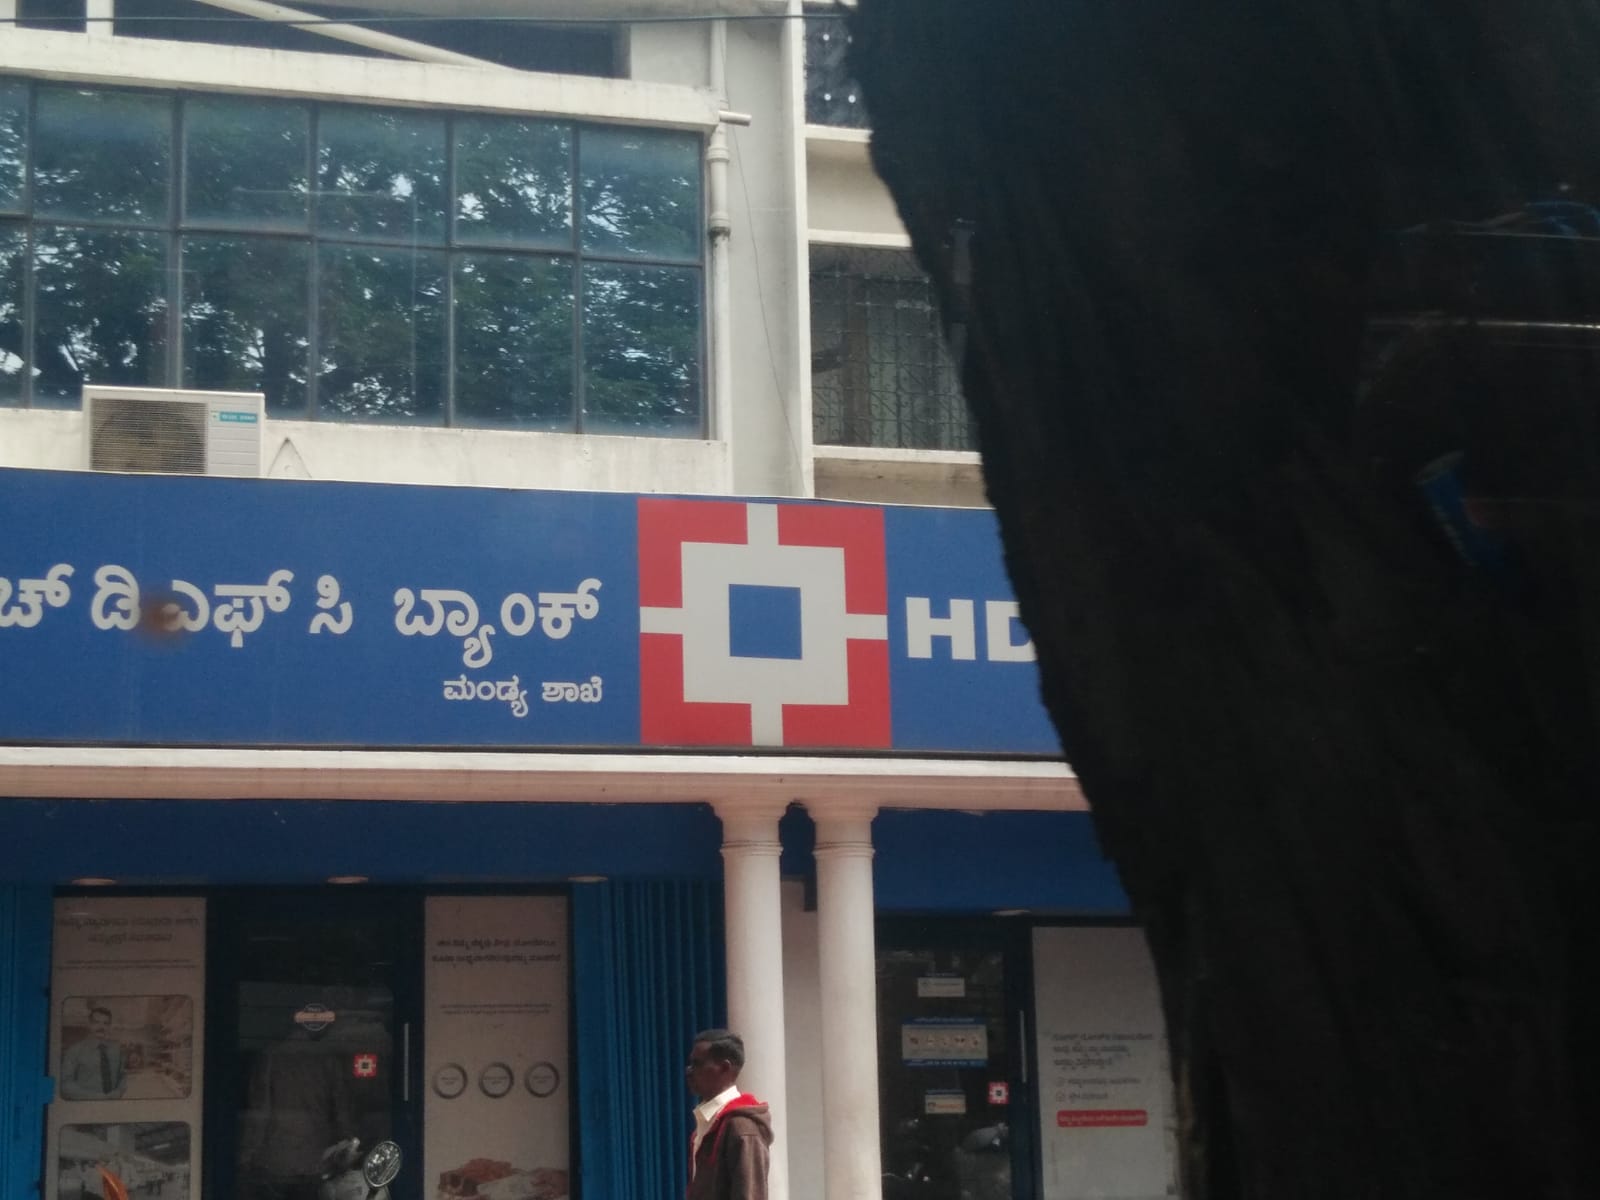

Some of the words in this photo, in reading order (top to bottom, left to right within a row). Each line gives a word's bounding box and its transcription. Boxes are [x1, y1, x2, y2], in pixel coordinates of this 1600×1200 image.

[309, 574, 353, 634] ಸಿ
[394, 578, 602, 669] ಬ್ಯಾಂಕ್
[443, 674, 528, 718] ಮಂಡ್ಯ
[542, 676, 602, 702] ಶಾಖೆ
